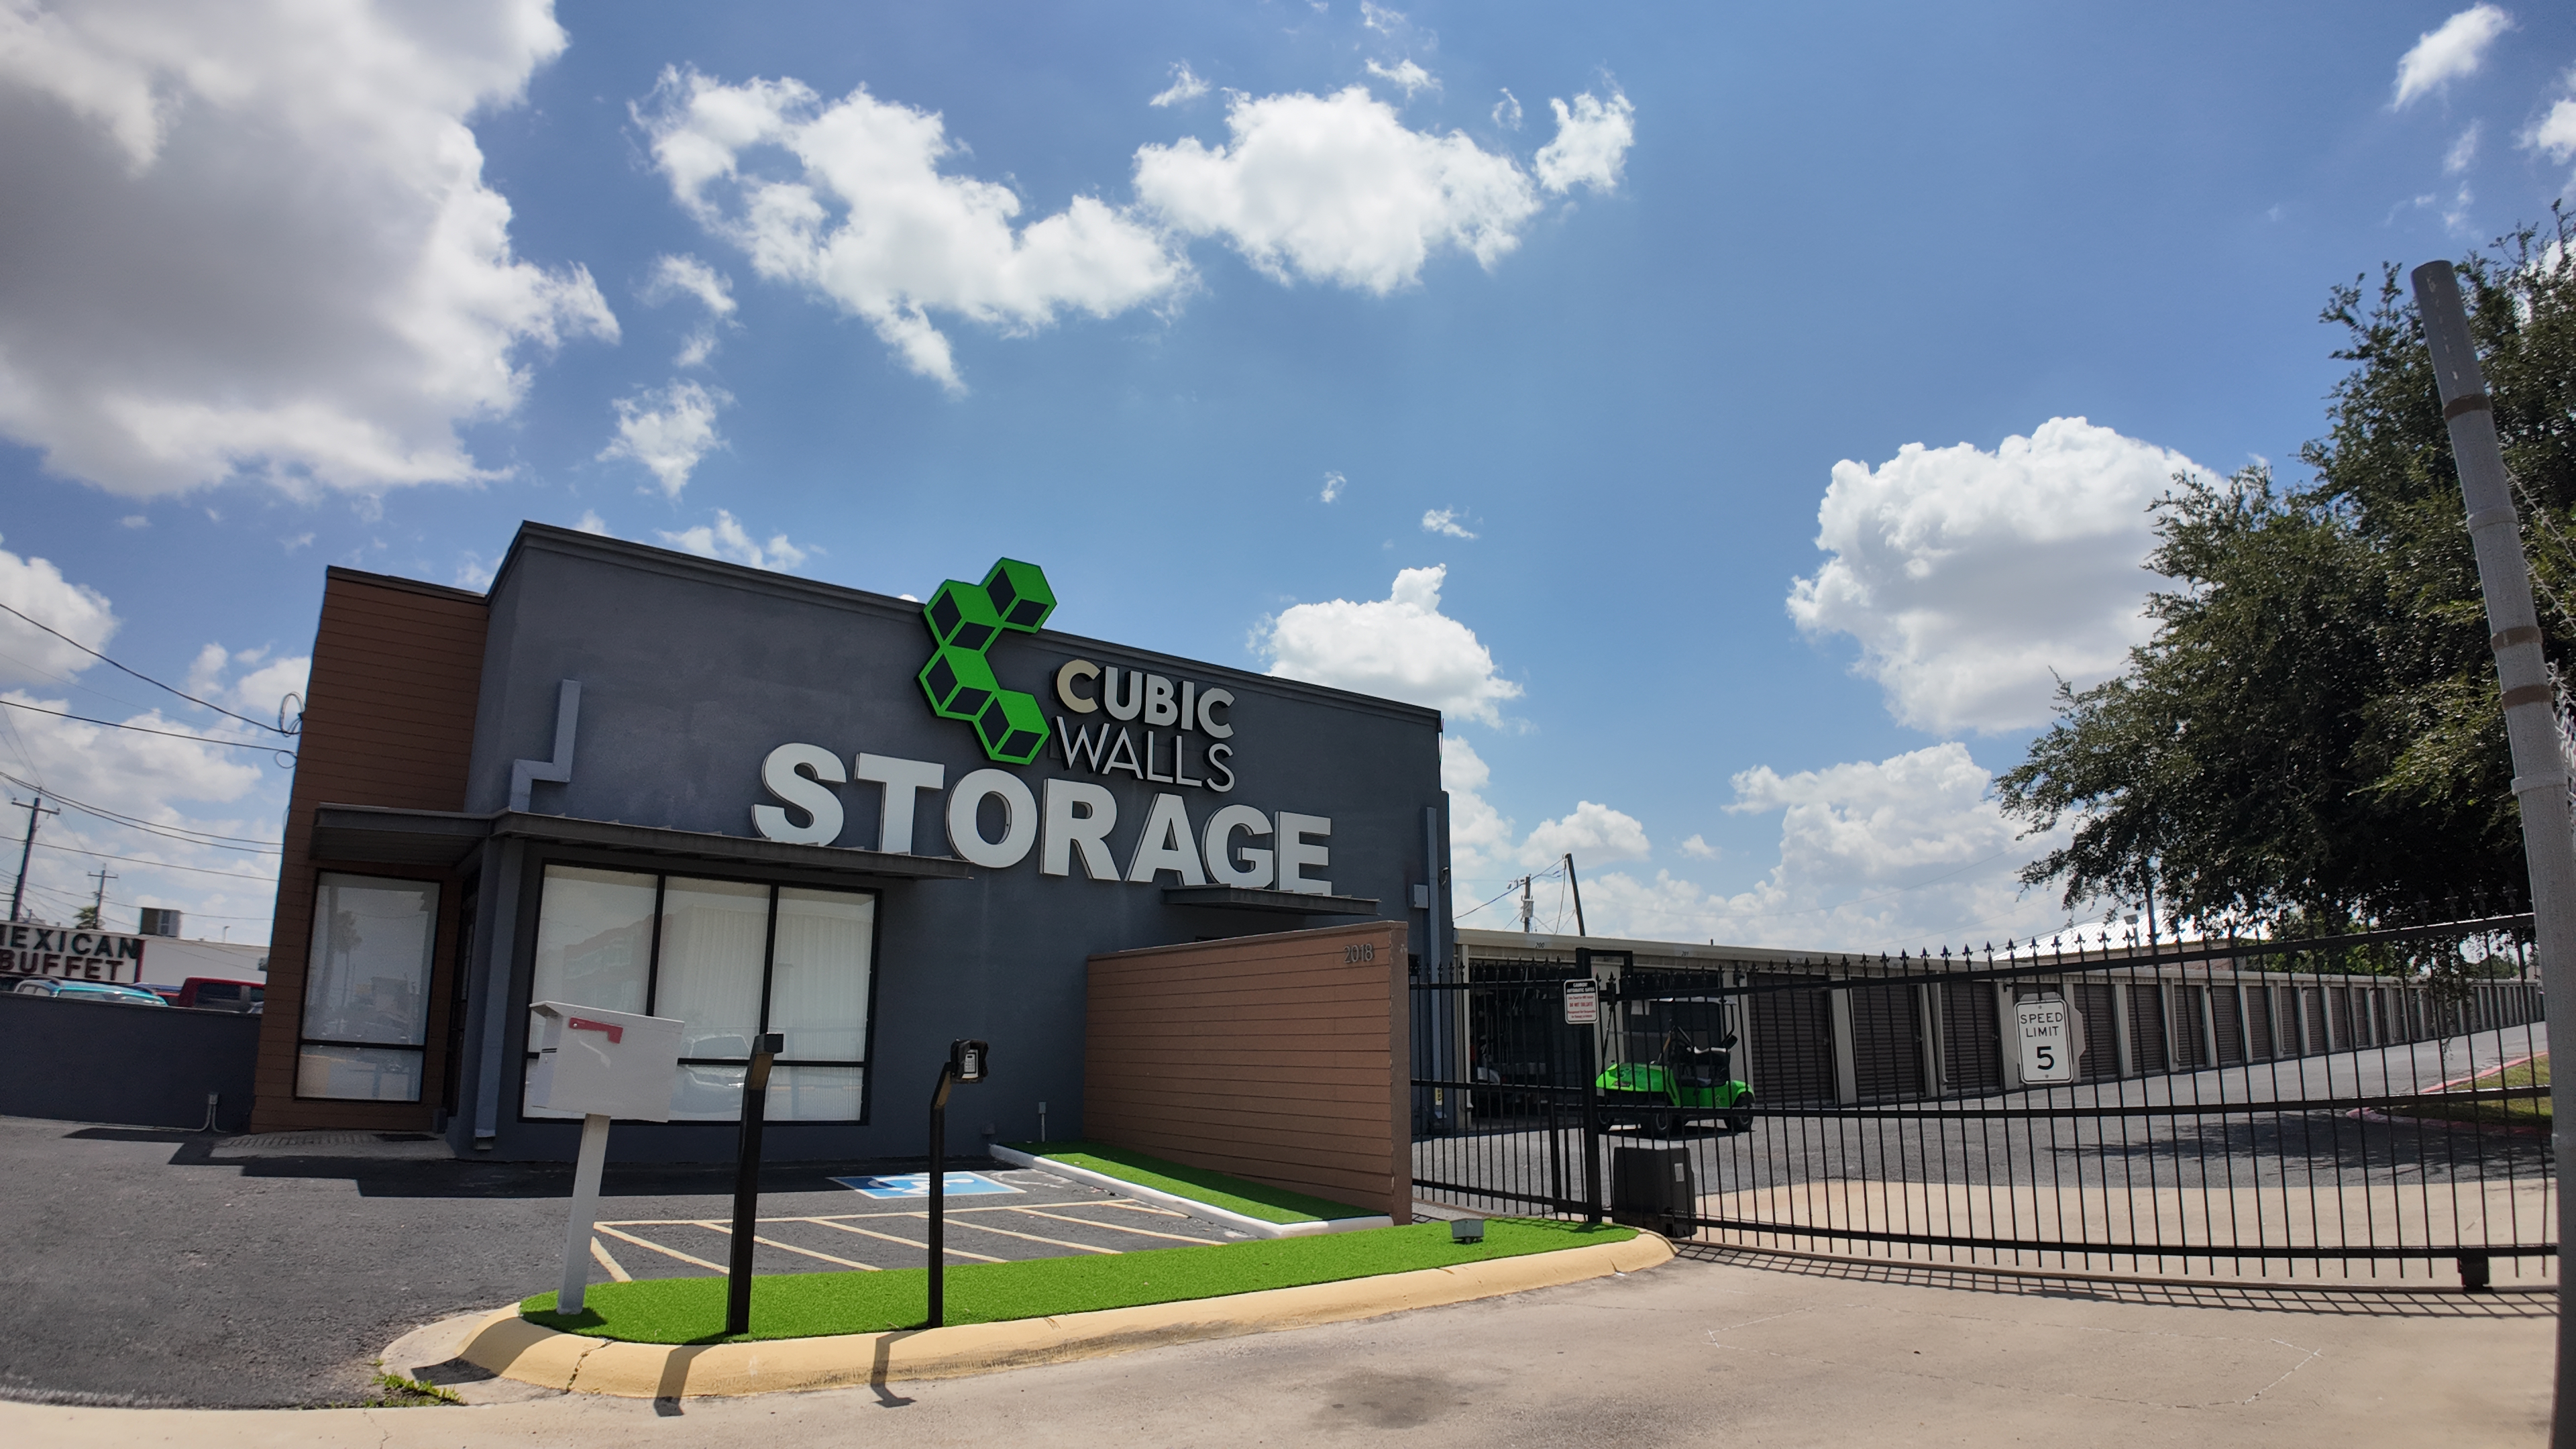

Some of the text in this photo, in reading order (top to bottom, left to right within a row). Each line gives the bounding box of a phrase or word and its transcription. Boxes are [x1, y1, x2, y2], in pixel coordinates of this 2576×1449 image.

[1056, 659, 1236, 739] CUBIC
[1055, 715, 1236, 792] WALLS
[751, 743, 1332, 897] STORAGE
[0, 949, 124, 981] BUFFET
[1343, 943, 1373, 963] 2018
[2020, 1012, 2063, 1024] SPEED
[2025, 1026, 2059, 1038] LIMIT
[2037, 1045, 2055, 1071] 5
